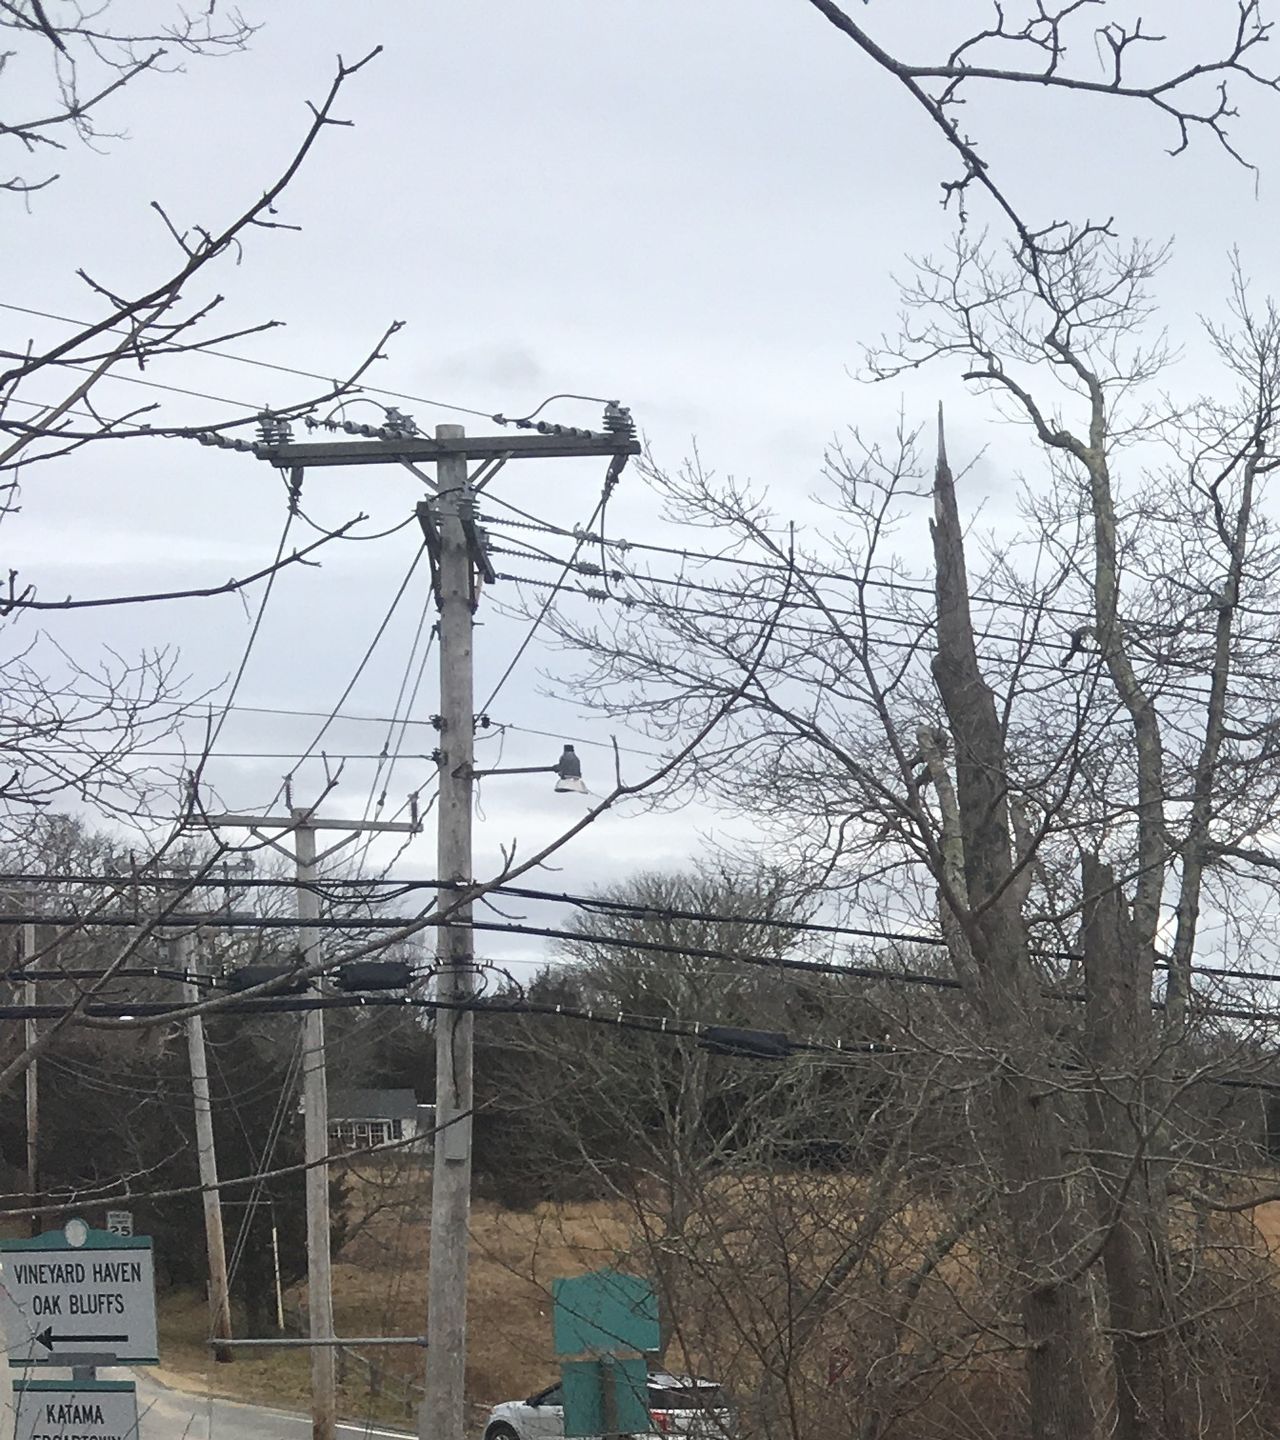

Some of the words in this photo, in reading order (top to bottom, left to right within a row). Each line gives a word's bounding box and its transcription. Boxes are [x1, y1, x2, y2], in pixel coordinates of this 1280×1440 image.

[110, 1226, 131, 1237] 25
[14, 1264, 85, 1284] VINEYARD
[93, 1262, 142, 1282] HAVEN
[33, 1295, 62, 1315] OAK
[69, 1294, 125, 1314] BLUFFS
[46, 1404, 104, 1424] KATAMA
